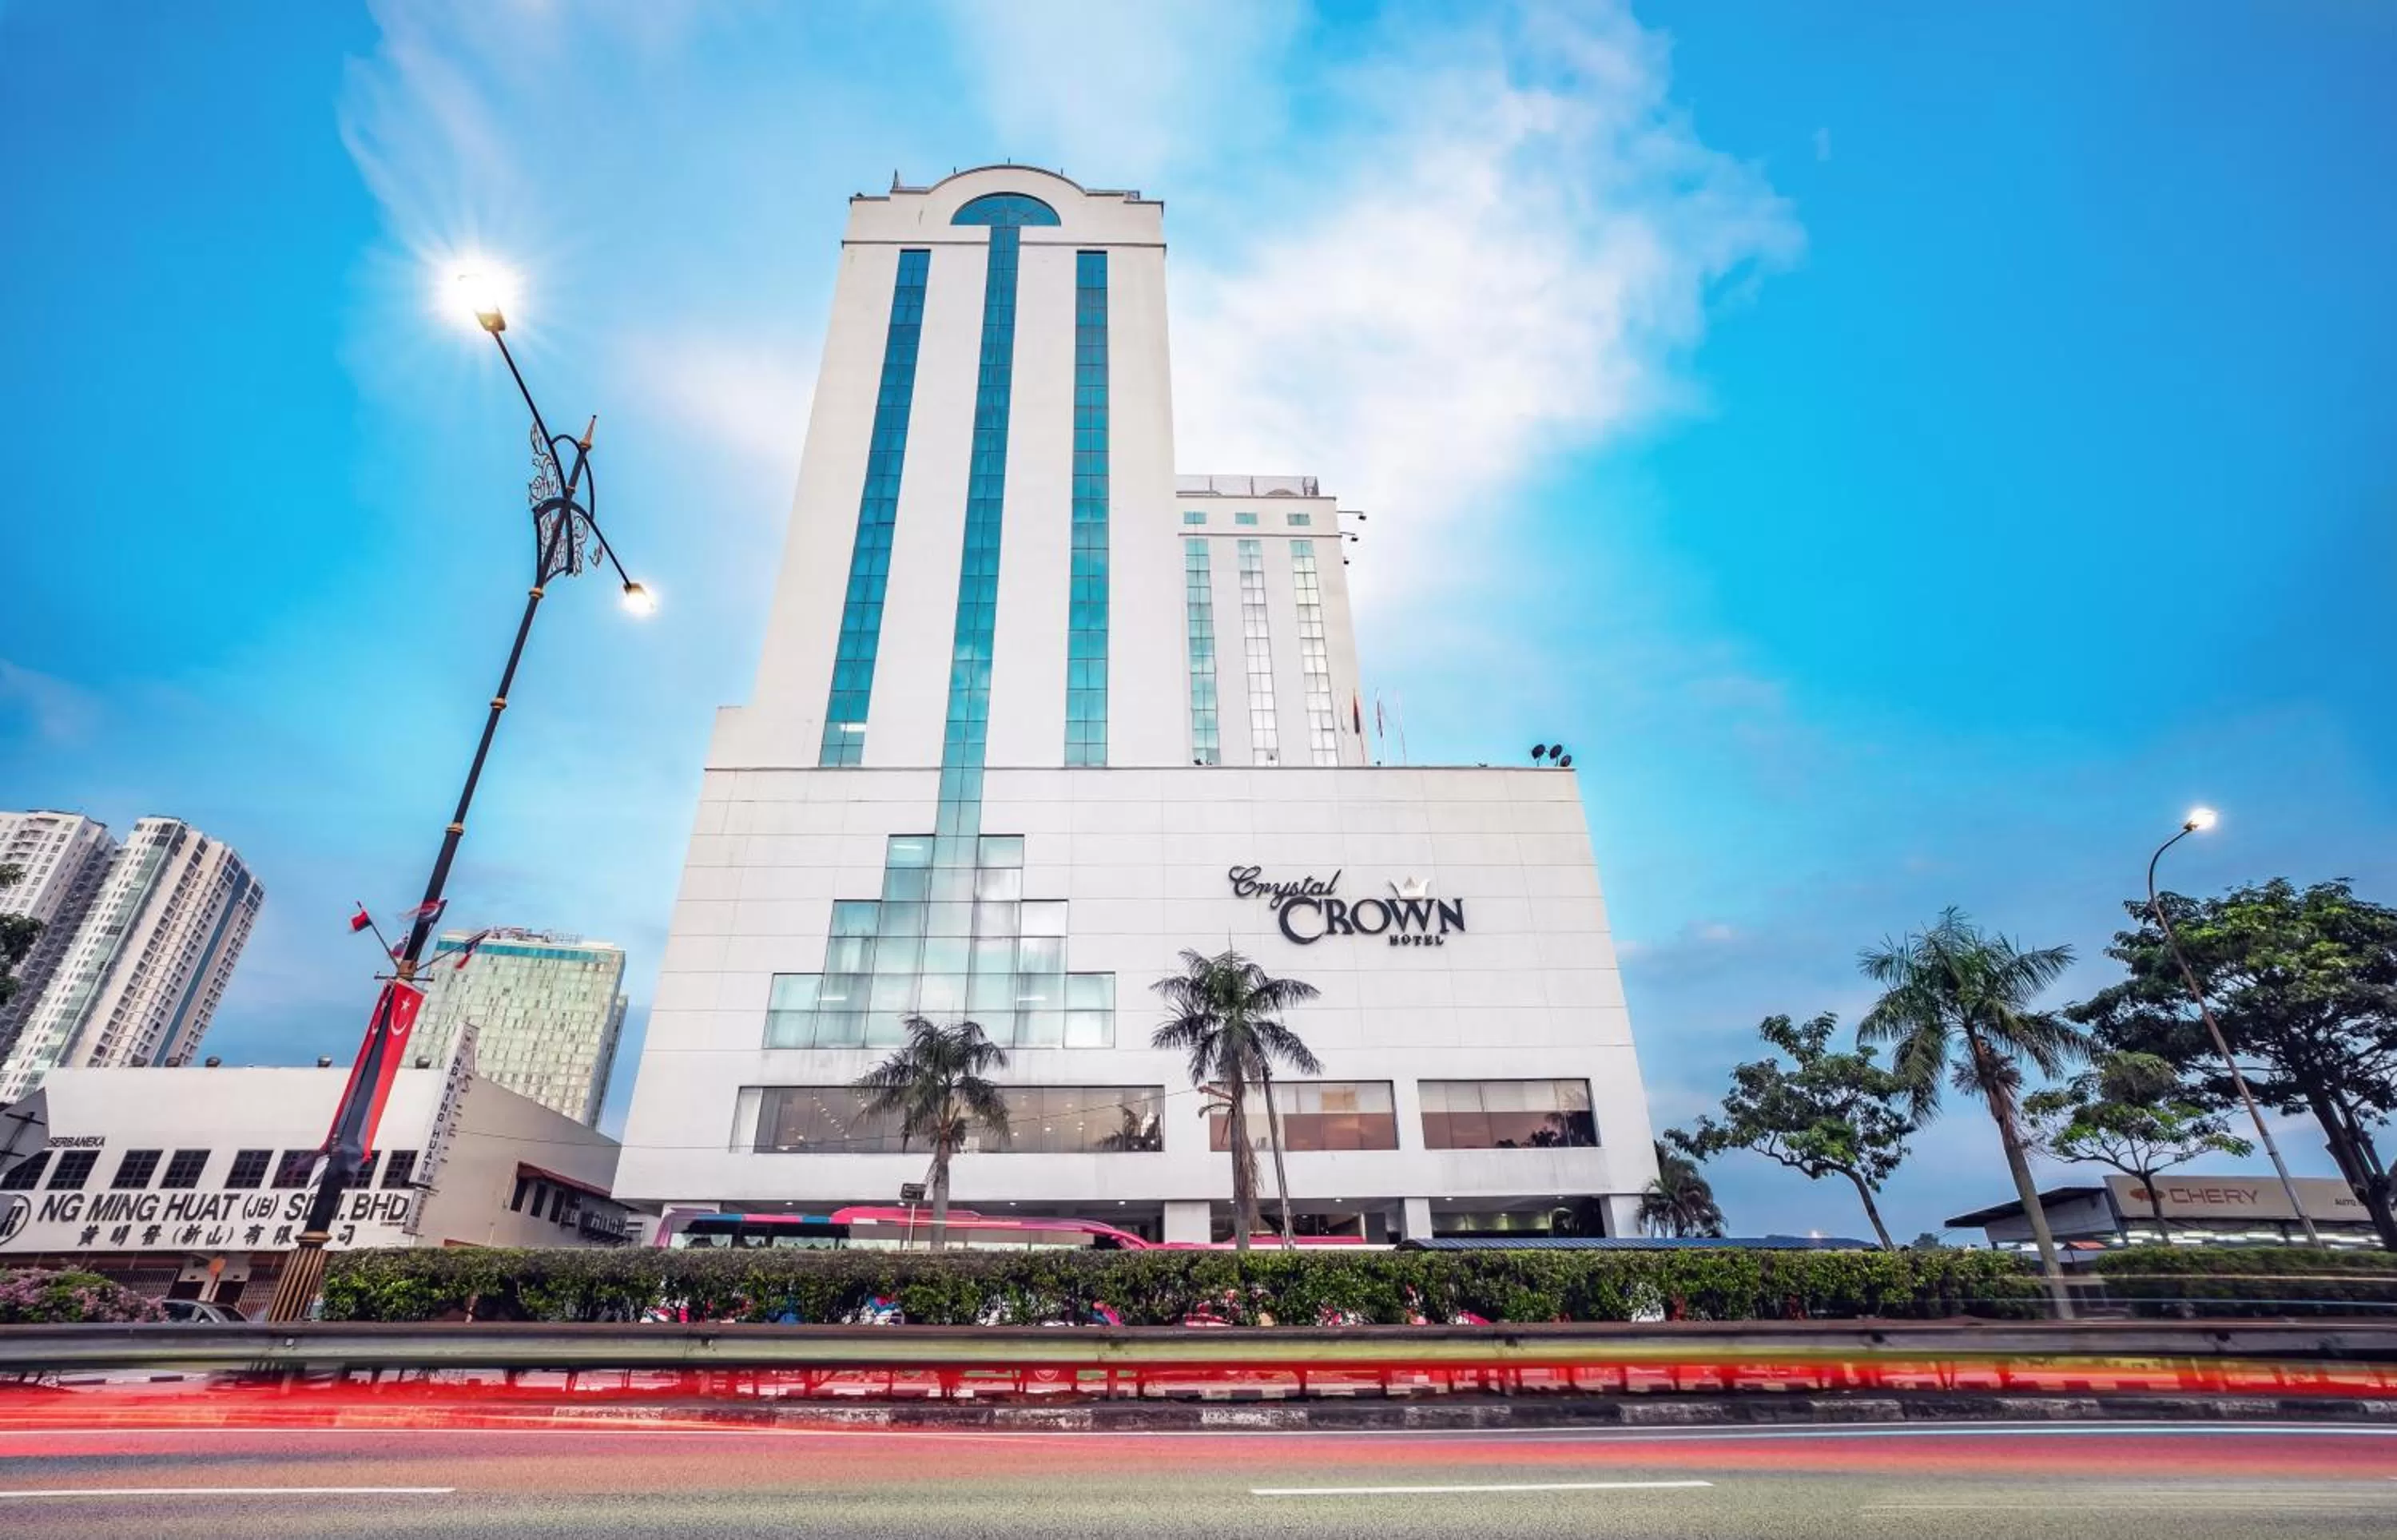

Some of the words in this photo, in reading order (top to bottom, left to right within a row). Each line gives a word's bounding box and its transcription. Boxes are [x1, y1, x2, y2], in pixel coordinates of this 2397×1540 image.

[1228, 865, 1342, 911] Crystal
[1279, 896, 1466, 945] CROWN
[1389, 934, 1445, 947] HOTEL
[423, 1129, 440, 1171] HUAT
[38, 1193, 84, 1222] NG
[85, 1193, 160, 1222] MING
[162, 1193, 241, 1221] HUAT
[242, 1194, 280, 1220] (JB)
[2168, 1188, 2259, 1205] CHERY
